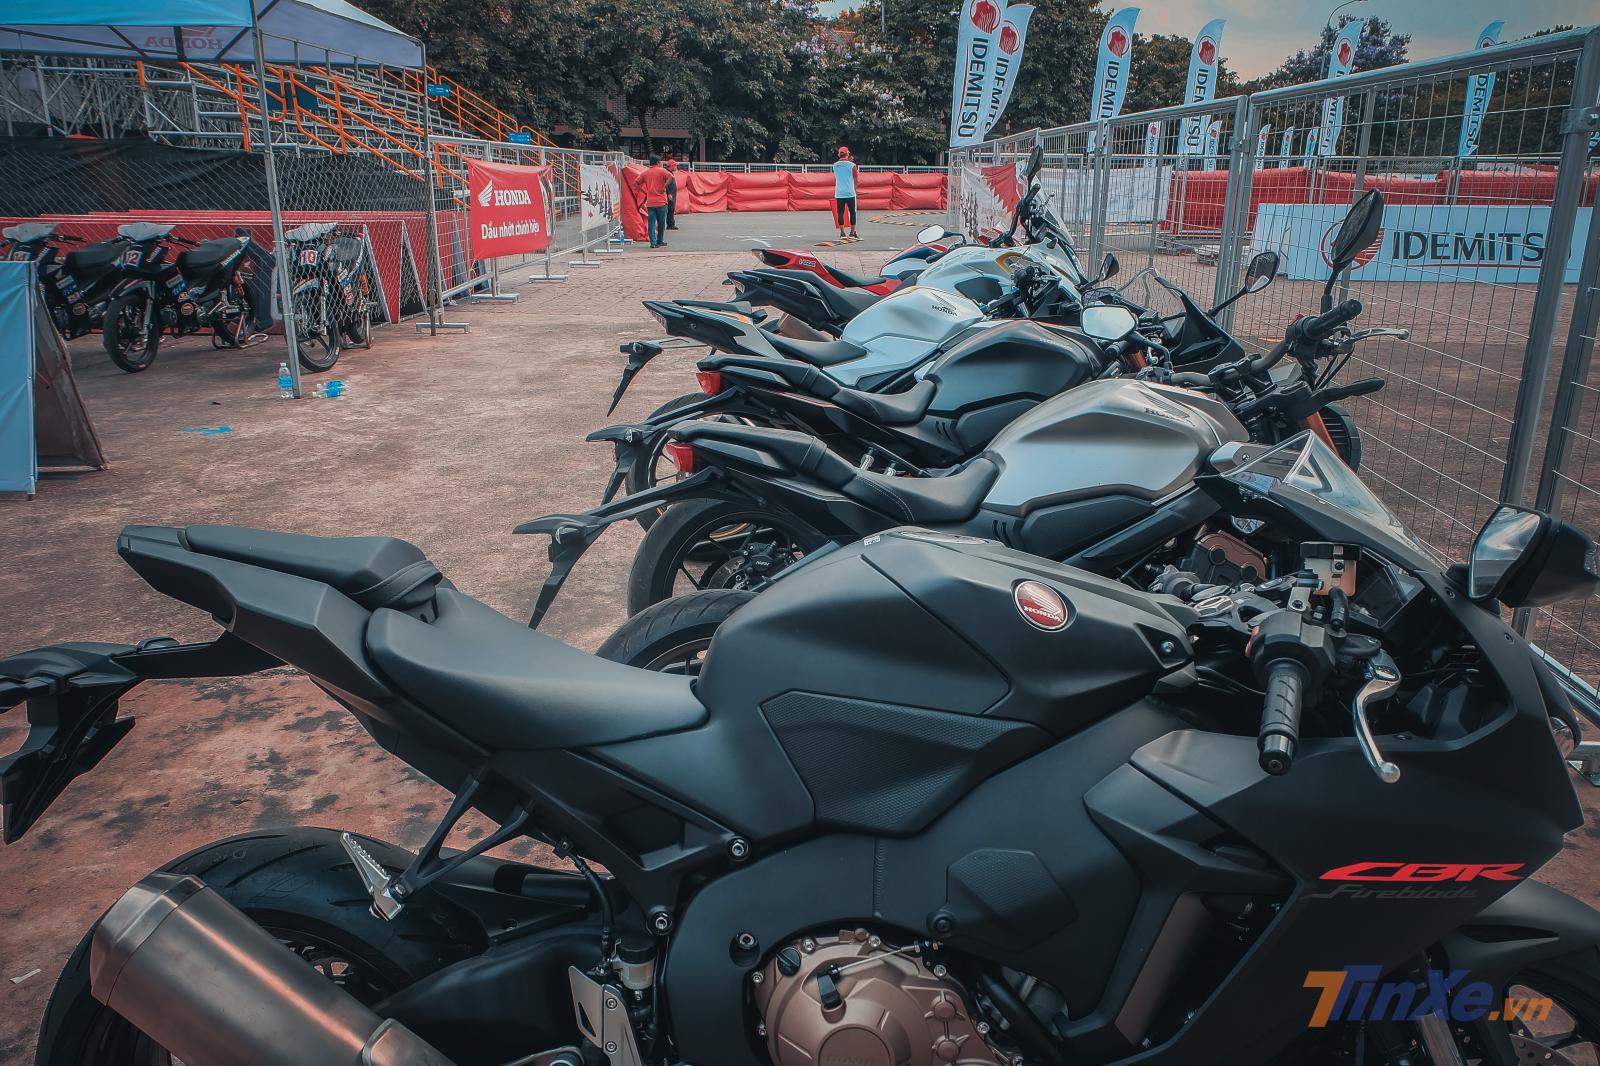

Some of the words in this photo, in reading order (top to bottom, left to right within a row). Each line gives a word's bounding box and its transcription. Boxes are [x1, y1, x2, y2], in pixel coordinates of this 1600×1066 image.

[957, 37, 988, 138] IDEMITSU
[1186, 68, 1208, 147] IDEMTSU
[1466, 74, 1489, 149] DEMITSU
[494, 189, 532, 206] HONDA
[481, 220, 498, 240] Dấu
[499, 221, 515, 238] nhớt
[1393, 231, 1571, 262] IDEMITS
[931, 304, 958, 317] HONDA
[1023, 605, 1063, 623] HONDA
[1319, 862, 1526, 882] CBR
[1301, 884, 1480, 899] Fireblade
